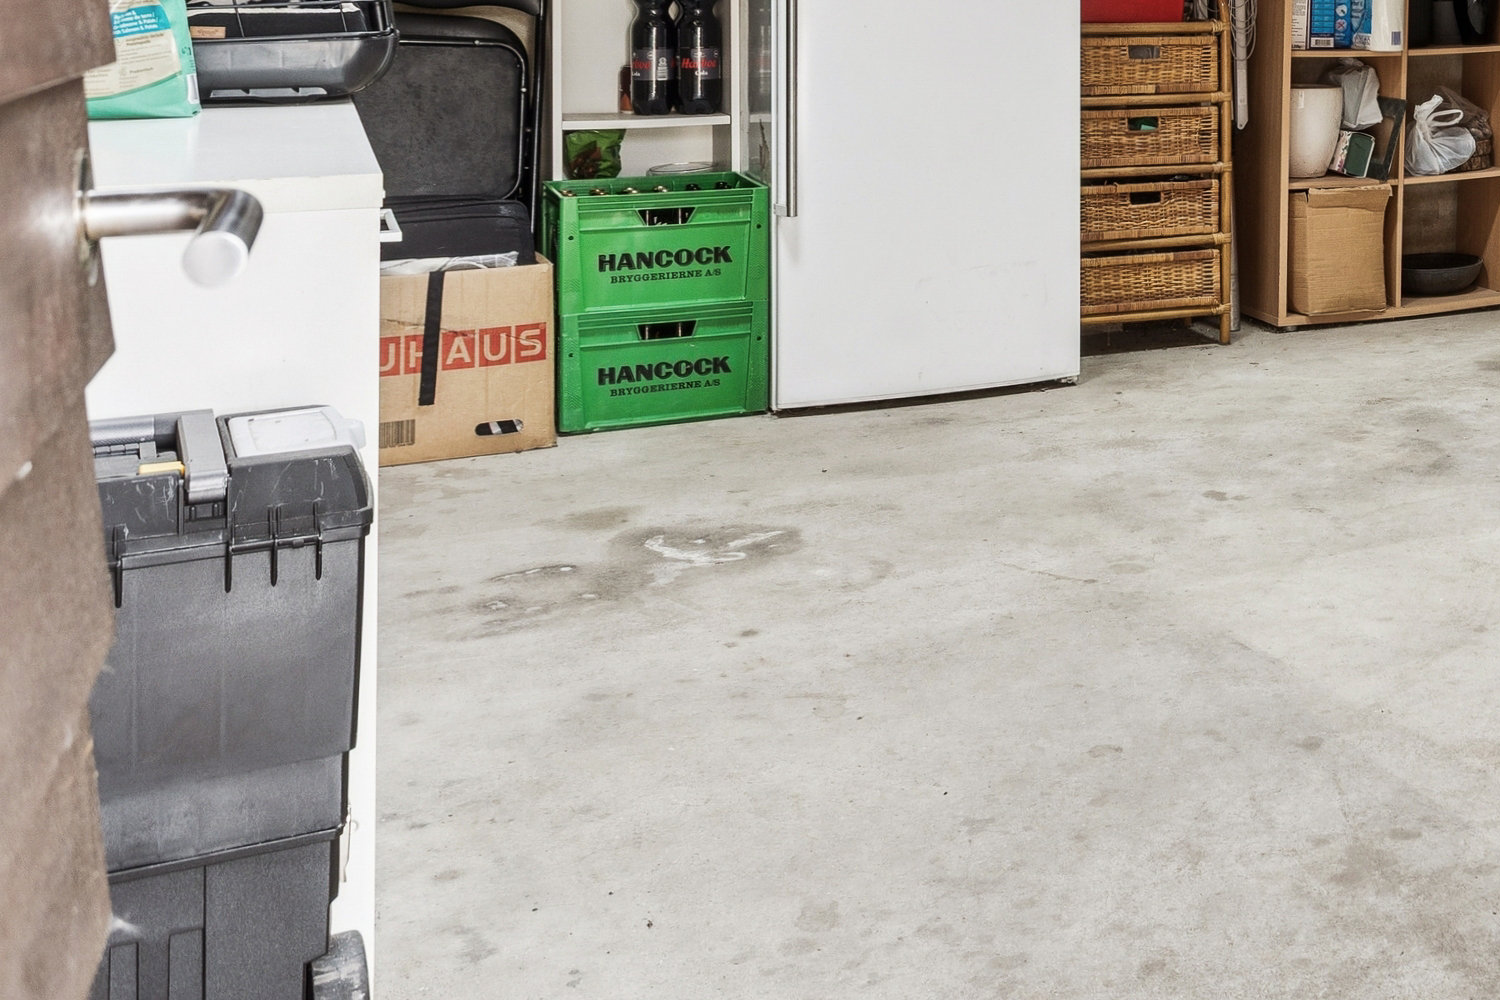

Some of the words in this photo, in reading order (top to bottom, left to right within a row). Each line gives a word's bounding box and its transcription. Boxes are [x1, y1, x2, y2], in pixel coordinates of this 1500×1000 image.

[598, 245, 733, 272] HANCOCK
[610, 270, 702, 284] BRYGGERIERNE
[704, 268, 722, 277] A/S
[598, 356, 732, 385] HANCOCK
[610, 381, 701, 397] BRYGGERIERNE
[704, 379, 721, 387] A/S
